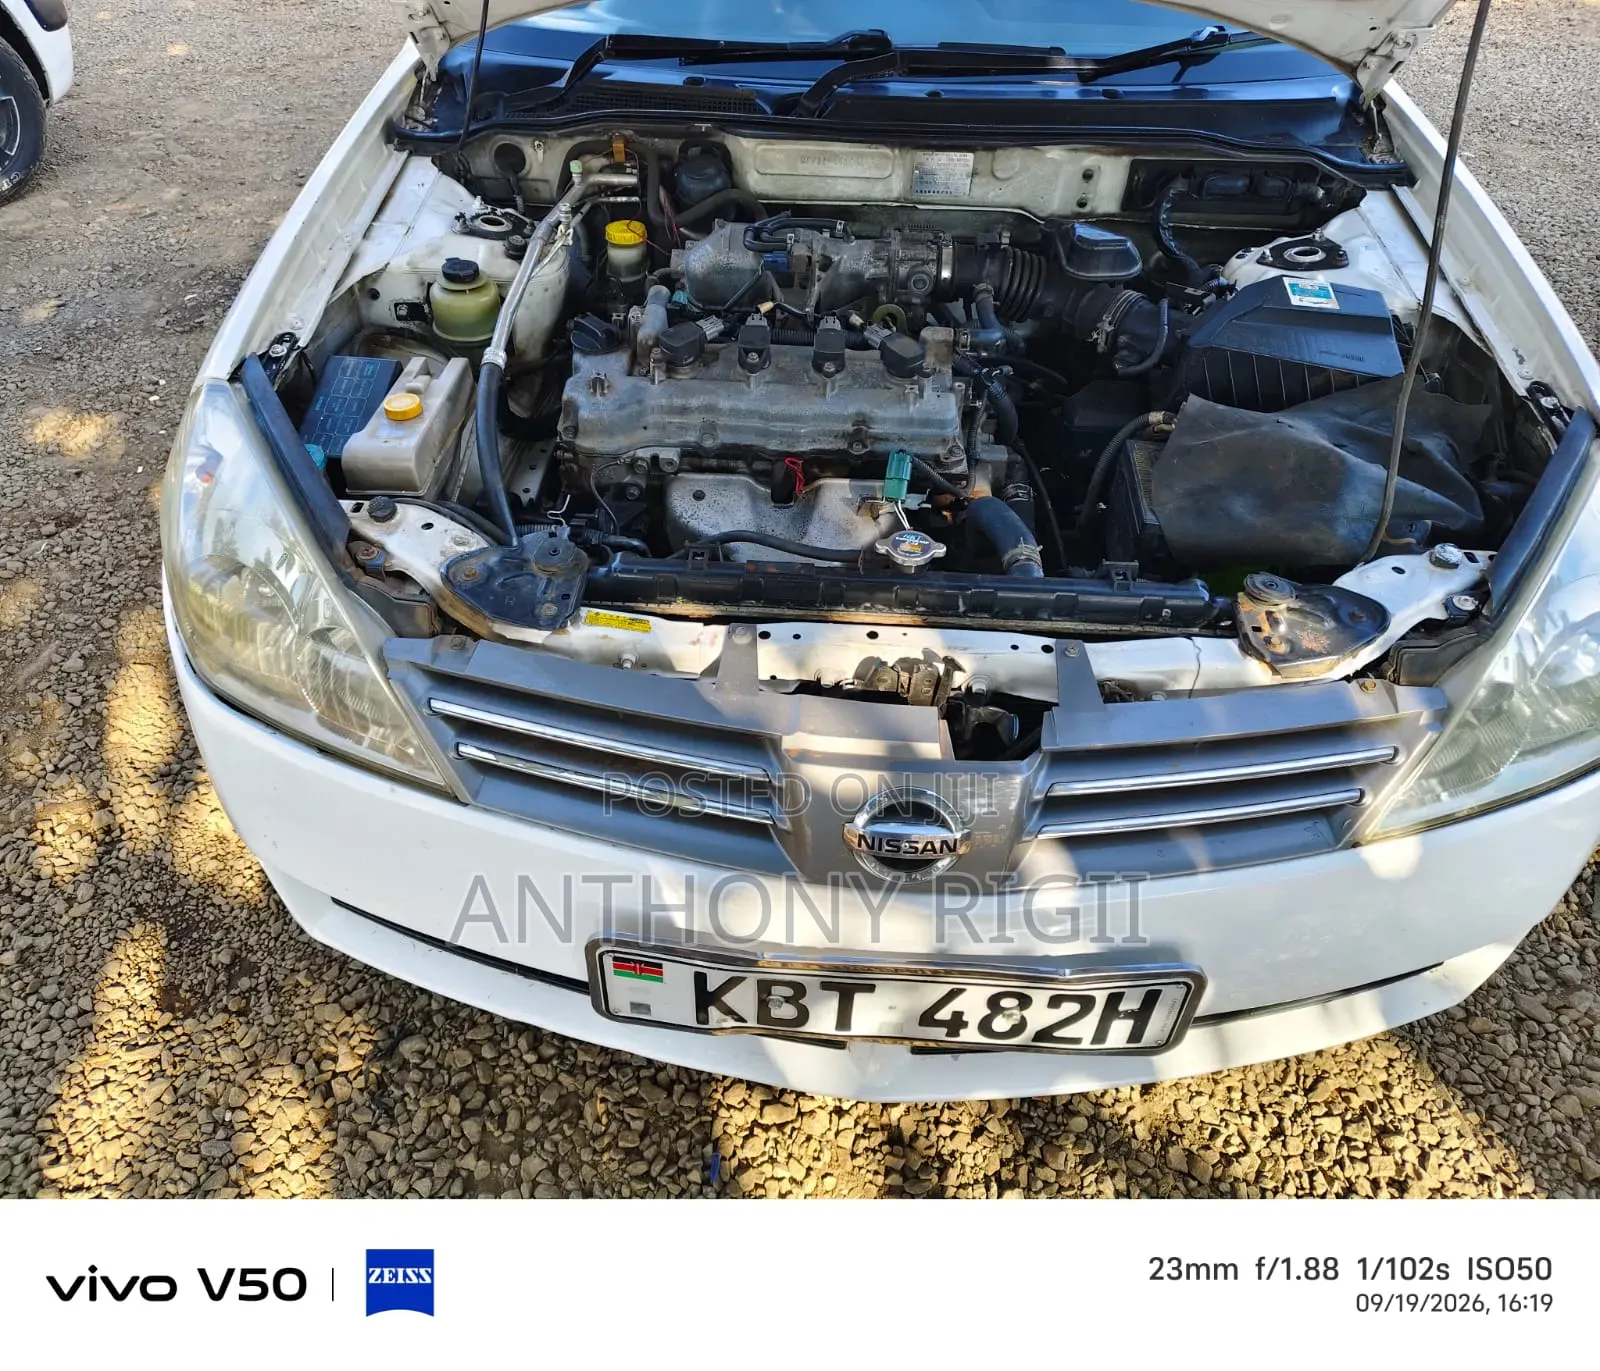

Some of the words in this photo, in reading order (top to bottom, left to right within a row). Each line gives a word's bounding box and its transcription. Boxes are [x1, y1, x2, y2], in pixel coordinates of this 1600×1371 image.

[857, 834, 959, 855] NISSAN
[693, 970, 876, 1032] KBT
[918, 988, 1163, 1046] 482H
